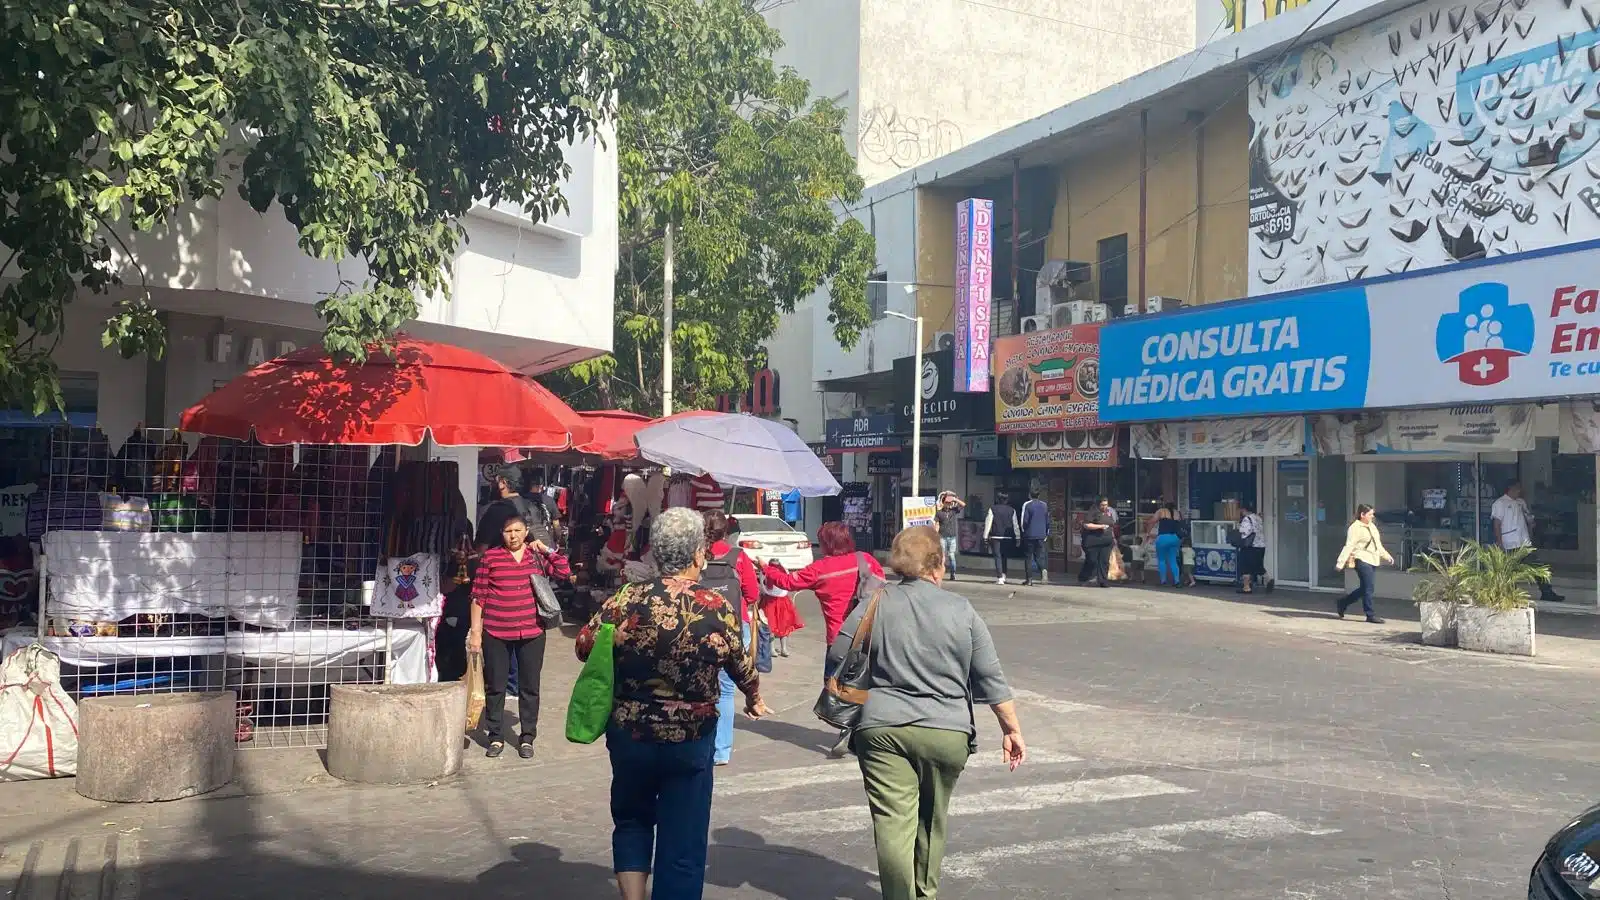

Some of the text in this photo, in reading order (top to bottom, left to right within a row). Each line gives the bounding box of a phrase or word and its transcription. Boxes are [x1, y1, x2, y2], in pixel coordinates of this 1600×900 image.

[957, 211, 968, 360] DENTISTA
[975, 209, 989, 360] DENTISTA
[1550, 285, 1599, 318] Fa
[1141, 316, 1300, 365] CONSULTA
[1108, 355, 1347, 407] MÉDICA GRATIS
[1549, 361, 1571, 377] Te
[903, 399, 957, 417] CAECITO
[1002, 407, 1034, 418] COMIDA
[1037, 405, 1062, 416] CHINA
[853, 418, 869, 432] ADA
[1018, 451, 1110, 462] COMIDA CHINA EXPRESS
